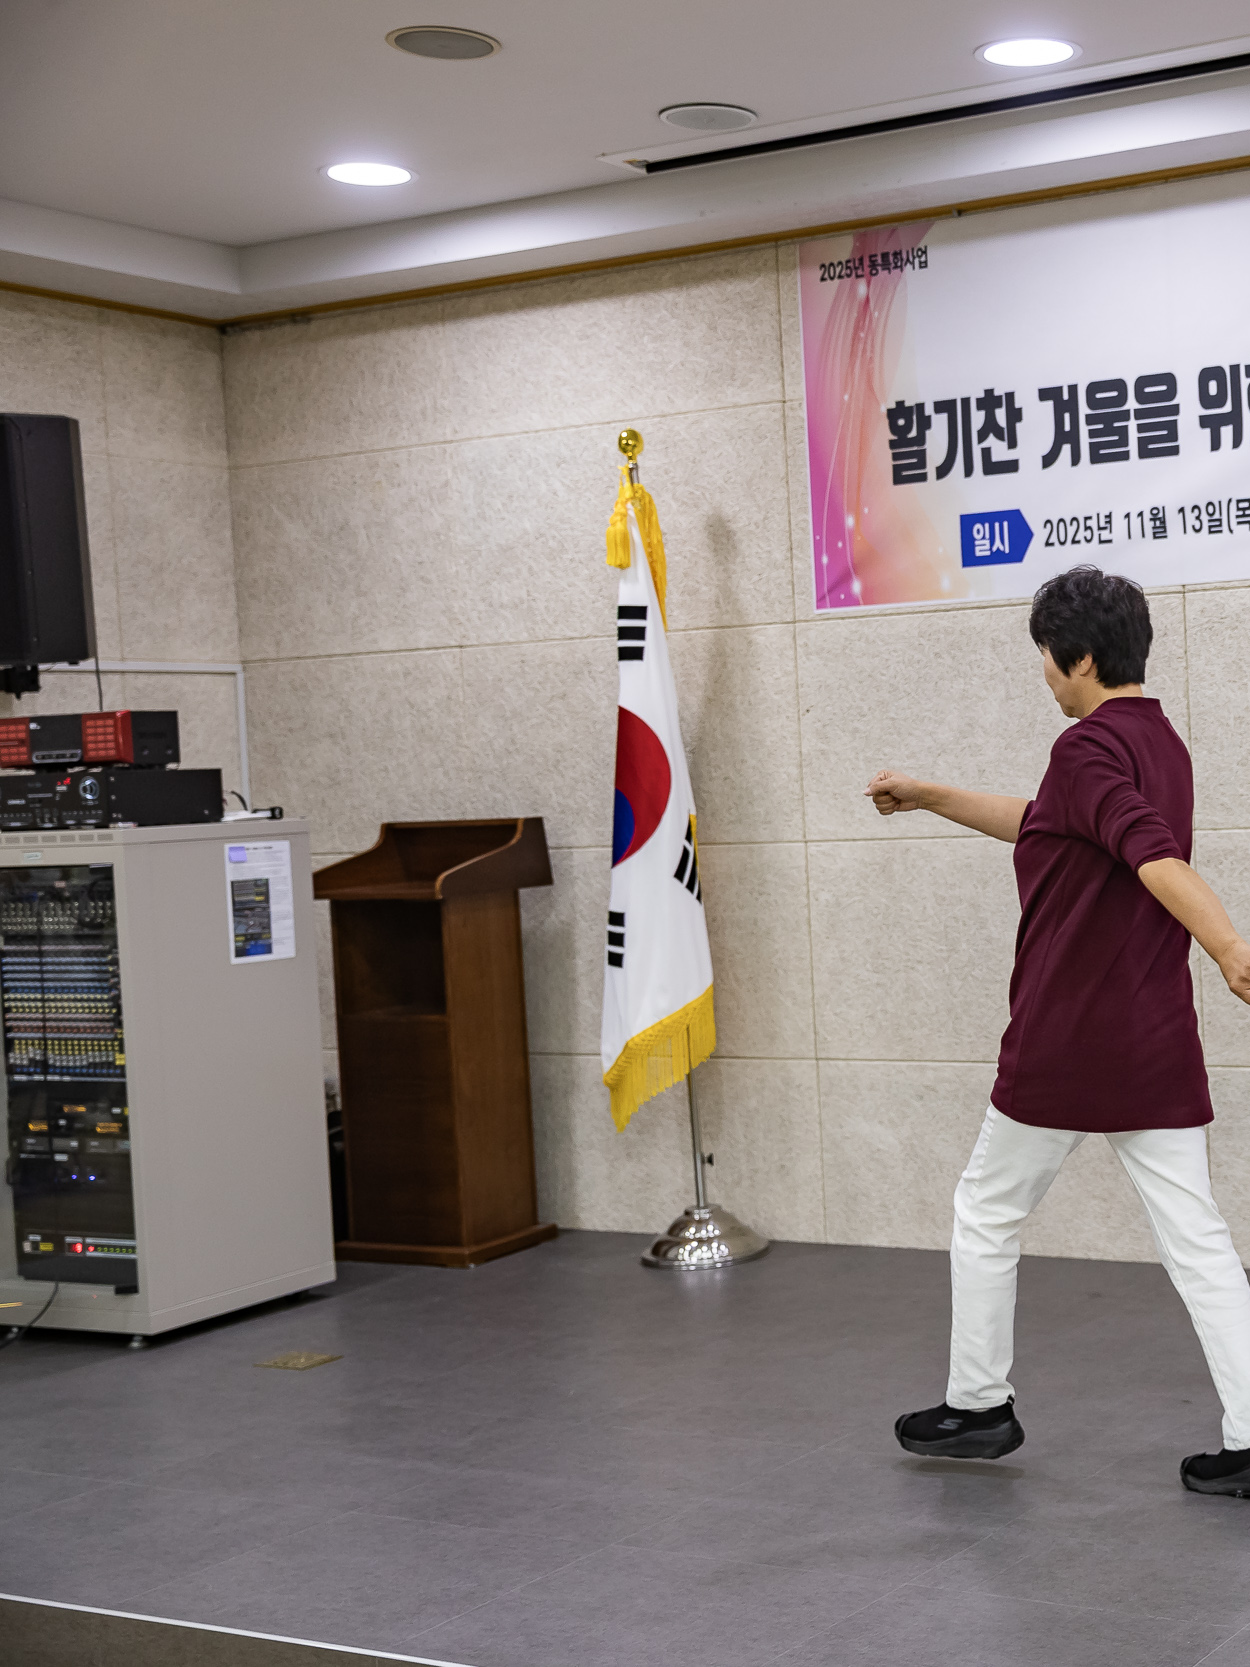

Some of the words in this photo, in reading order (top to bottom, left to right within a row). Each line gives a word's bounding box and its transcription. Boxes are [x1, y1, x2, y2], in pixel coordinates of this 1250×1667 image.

[819, 256, 865, 282] 2025년
[868, 245, 929, 277] 동특화사업
[886, 388, 1023, 487] 활기찬
[1038, 372, 1181, 469] 겨울을
[972, 520, 1010, 557] 일시
[1043, 511, 1114, 547] 2025년
[1124, 505, 1168, 541] 11월
